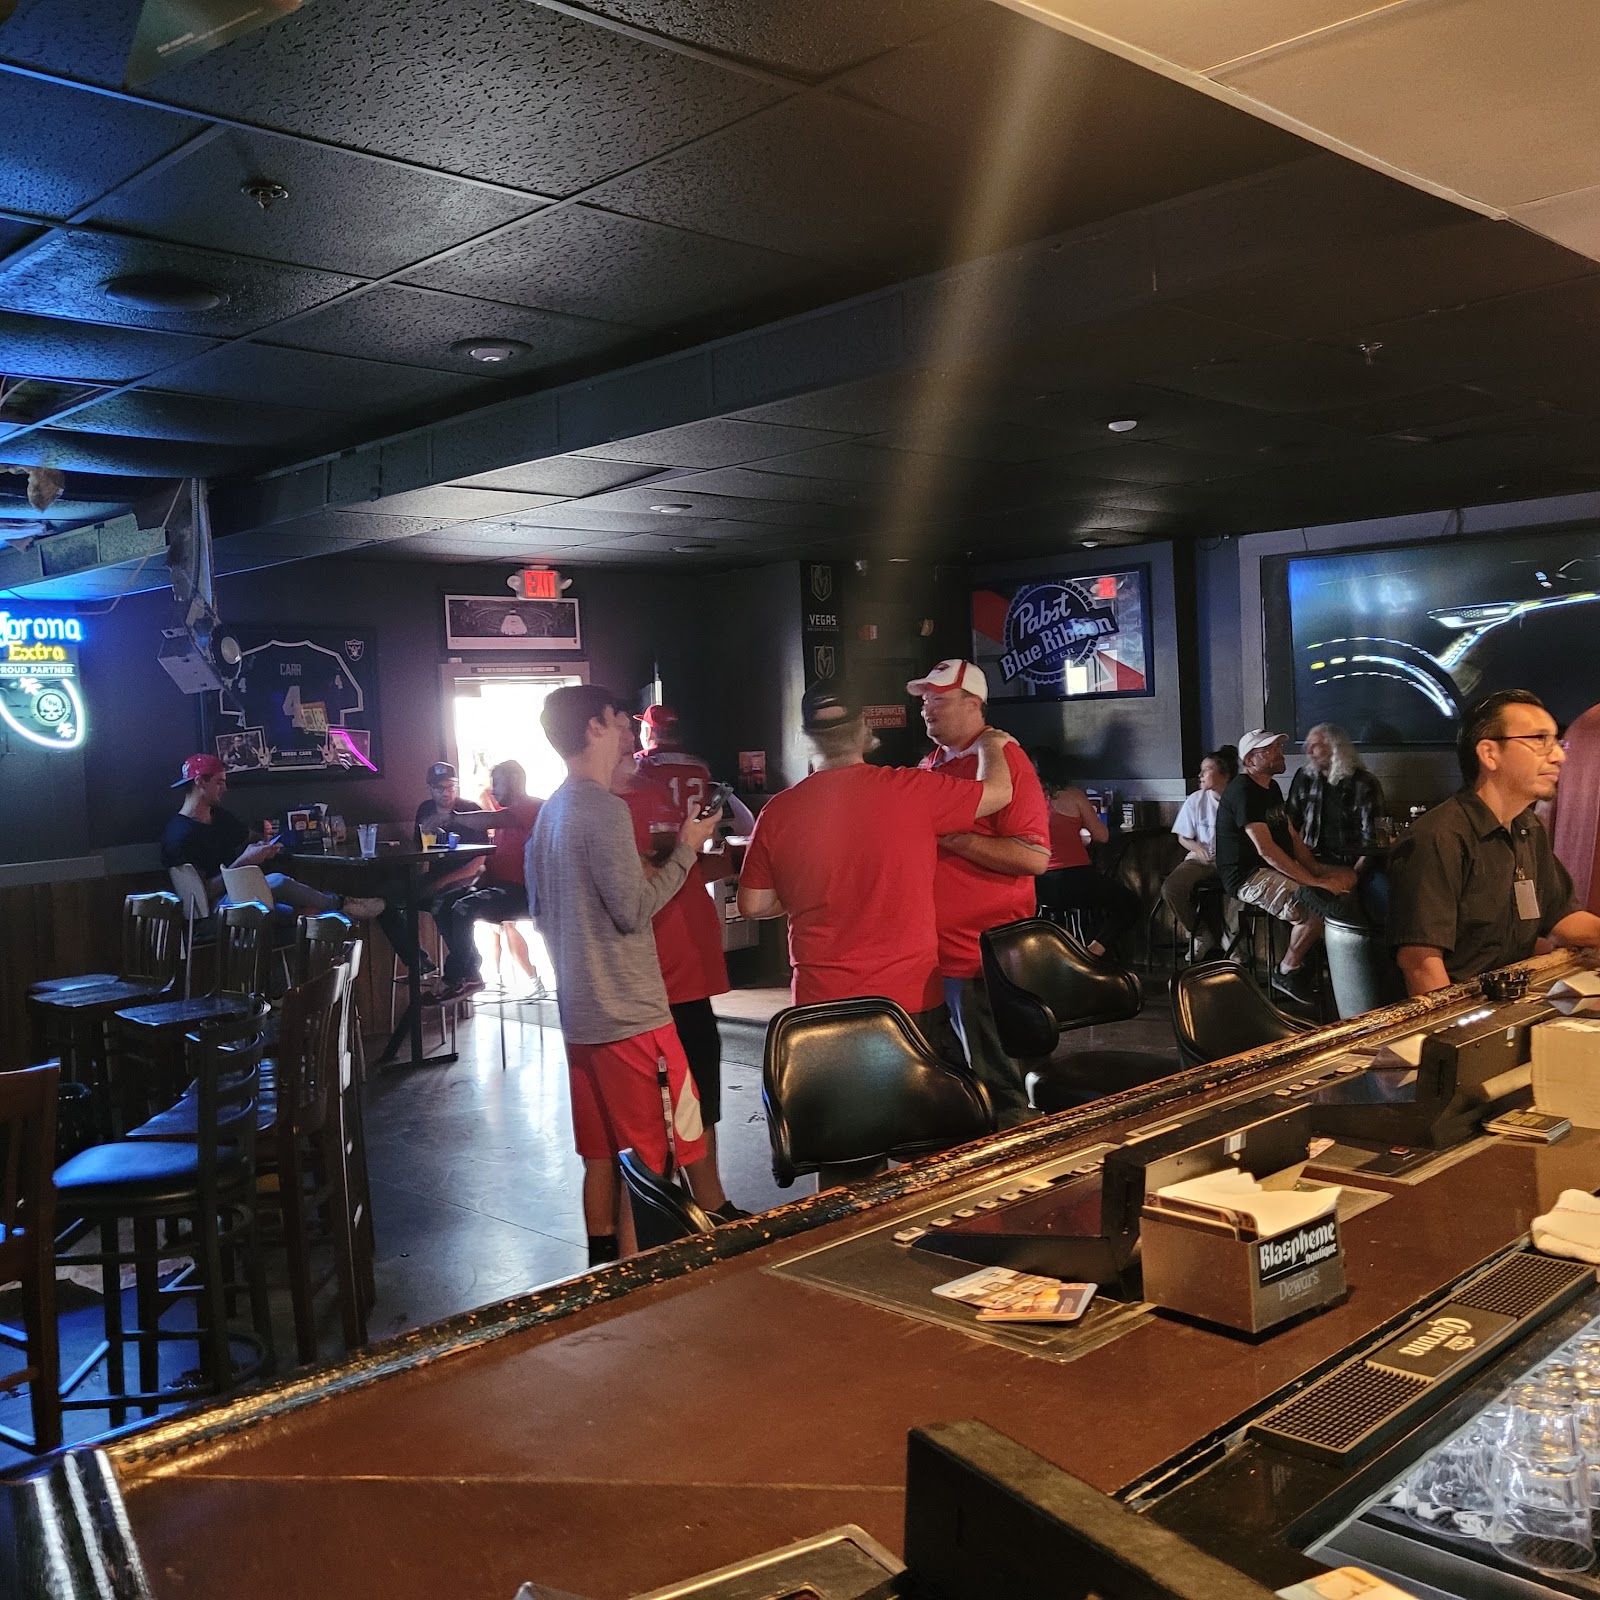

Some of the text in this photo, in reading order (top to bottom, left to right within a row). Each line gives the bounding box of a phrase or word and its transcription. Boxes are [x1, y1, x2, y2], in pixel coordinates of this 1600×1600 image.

[526, 572, 556, 598] EXIT
[809, 614, 837, 626] VEGAS
[1013, 592, 1071, 640] Pabst
[8, 641, 66, 661] Extra
[1000, 617, 1115, 681] Blue Ribbon
[280, 663, 302, 676] CARR
[875, 707, 905, 716] SPRINKLER
[884, 717, 901, 726] ROOM
[668, 776, 704, 817] 12
[1259, 1221, 1336, 1273] Blaspheme
[1399, 1317, 1472, 1357] Corona
